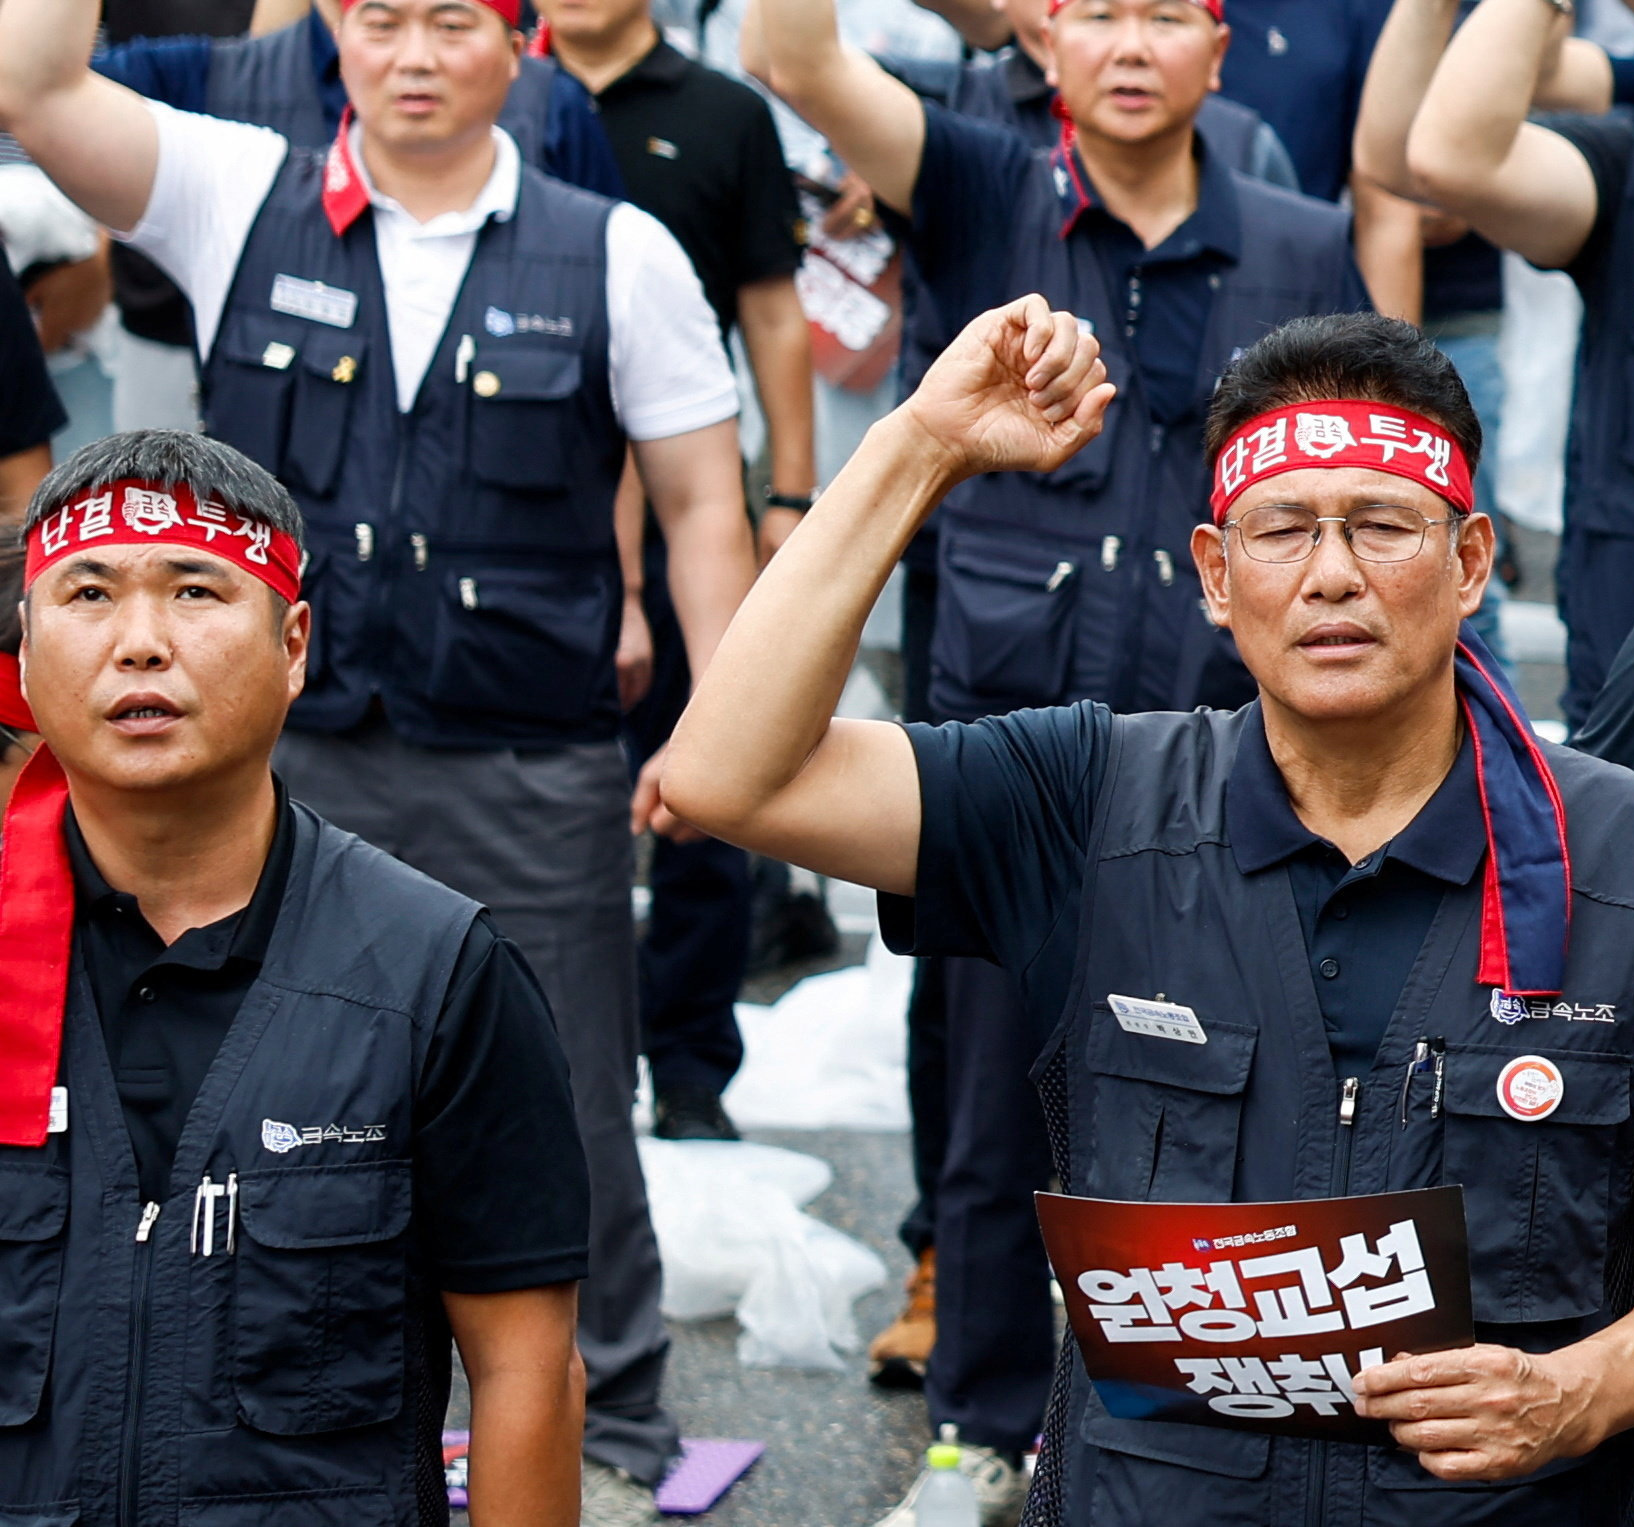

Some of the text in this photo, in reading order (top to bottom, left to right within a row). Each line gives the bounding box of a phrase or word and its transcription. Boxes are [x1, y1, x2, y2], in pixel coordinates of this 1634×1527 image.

[1221, 417, 1287, 496] 단결
[1360, 414, 1451, 487] 투쟁
[41, 491, 114, 556] 단결
[187, 499, 272, 565] 투쟁
[1530, 1000, 1616, 1022] 금속노조
[301, 1122, 386, 1145] 금속노조
[1212, 1224, 1297, 1250] 전국금속노동조합
[1077, 1218, 1436, 1344] 원청교섭
